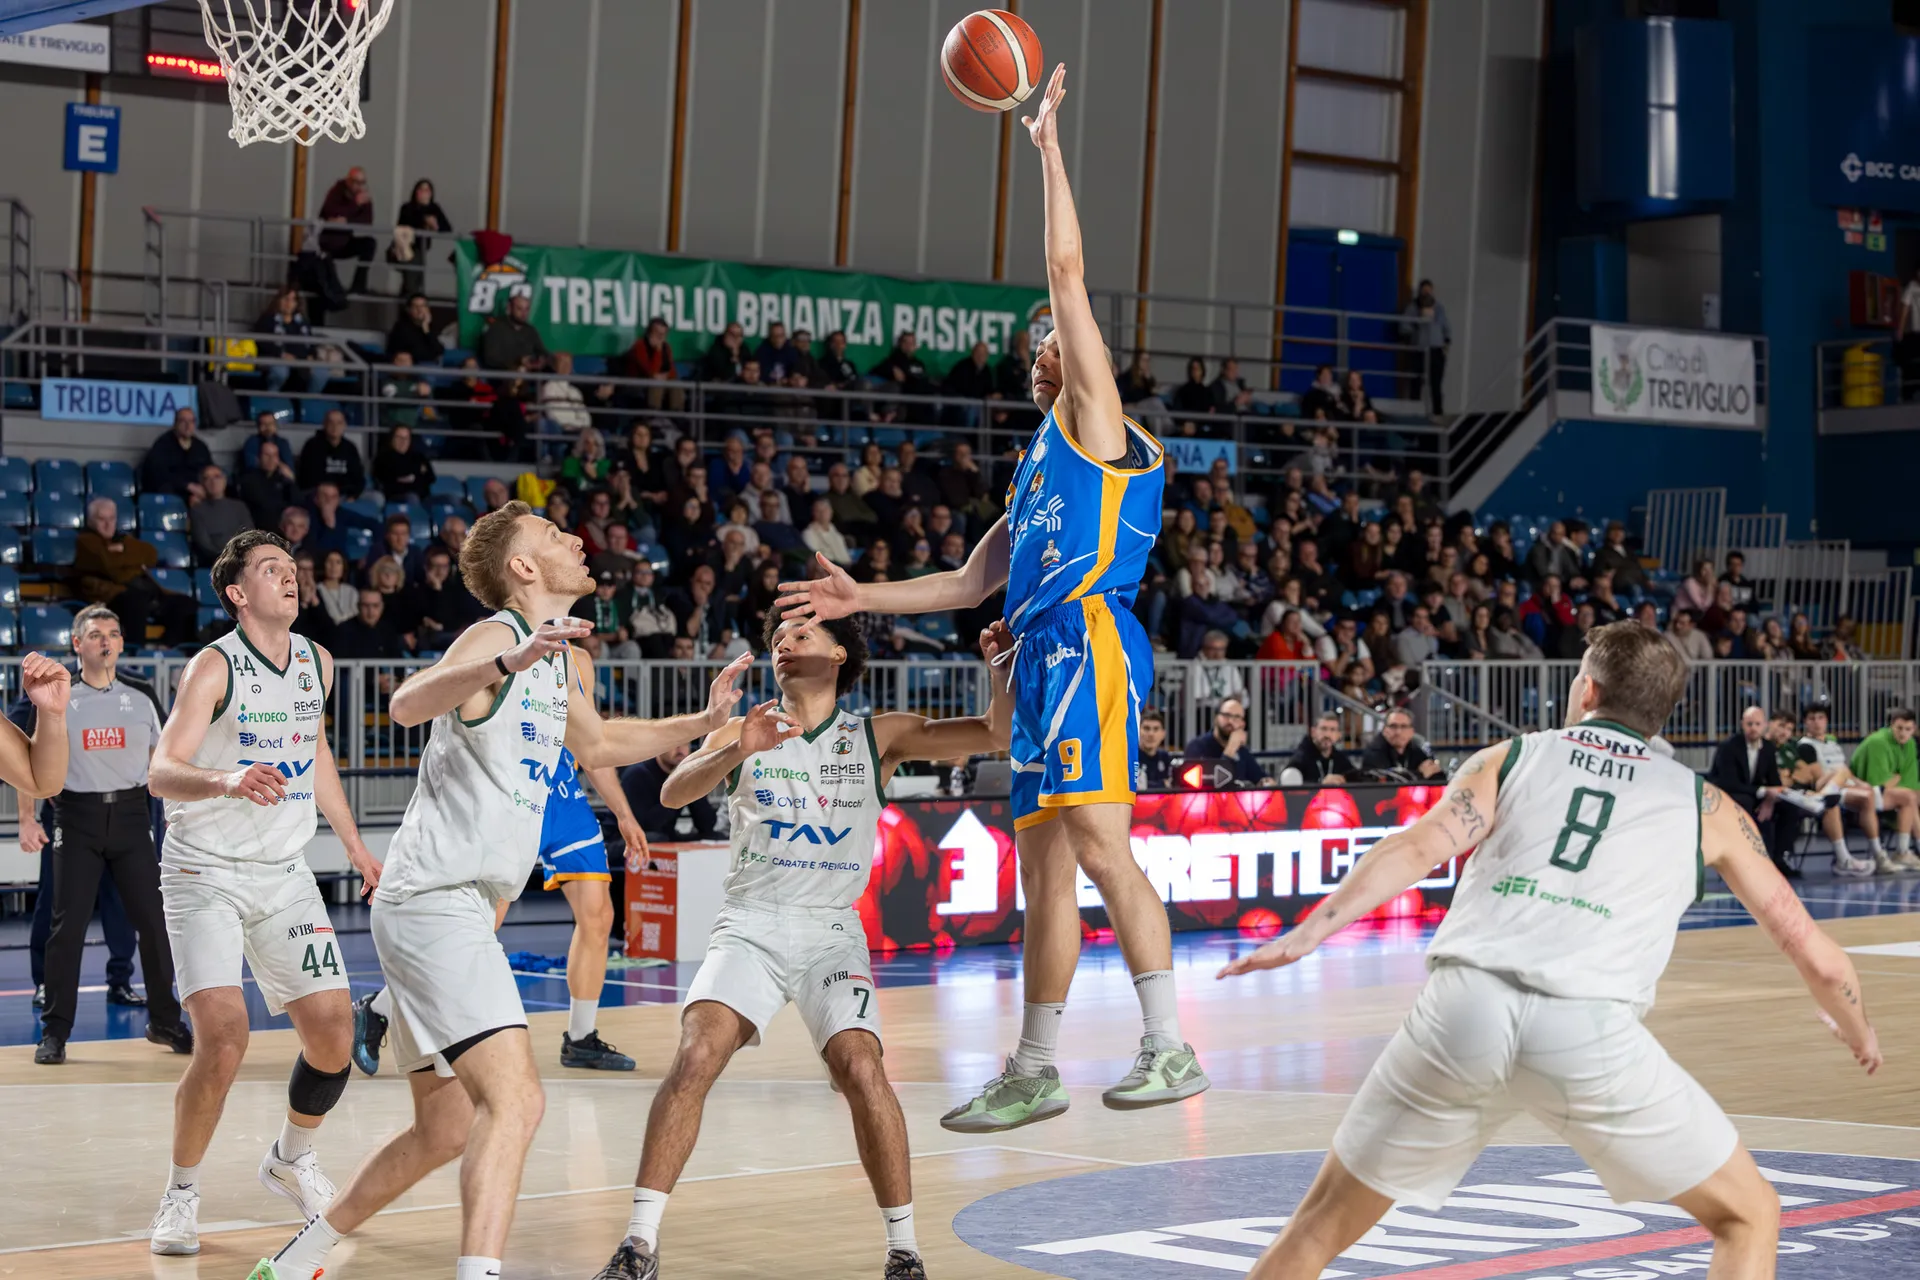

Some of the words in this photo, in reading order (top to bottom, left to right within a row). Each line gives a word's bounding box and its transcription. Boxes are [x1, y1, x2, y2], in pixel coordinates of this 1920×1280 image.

[39, 36, 106, 55] TREVIGLIO
[77, 124, 108, 163] E
[1865, 161, 1895, 179] BCC
[543, 276, 726, 335] TREVIGLIO
[736, 289, 883, 346] BRIANZA
[892, 303, 1016, 354] BASKET
[54, 384, 177, 418] TRIBUNA
[1647, 377, 1750, 415] TREVIGLIO
[233, 655, 257, 676] 44
[248, 712, 288, 722] FLYDECO
[87, 728, 122, 739] ATTAL
[87, 738, 122, 746] GROUP
[820, 763, 866, 775] REMER
[1058, 738, 1082, 781] 9
[1569, 749, 1635, 782] REATI
[763, 767, 810, 782] FLYDECO
[831, 797, 866, 809] Stucchi
[760, 819, 853, 846] TAV
[1549, 786, 1616, 873] 8
[772, 857, 809, 869] CARATE
[809, 861, 816, 870] E
[287, 923, 315, 940] AVIBI
[302, 942, 340, 978] 44
[822, 970, 849, 990] AVIBI
[853, 987, 869, 1018] 7
